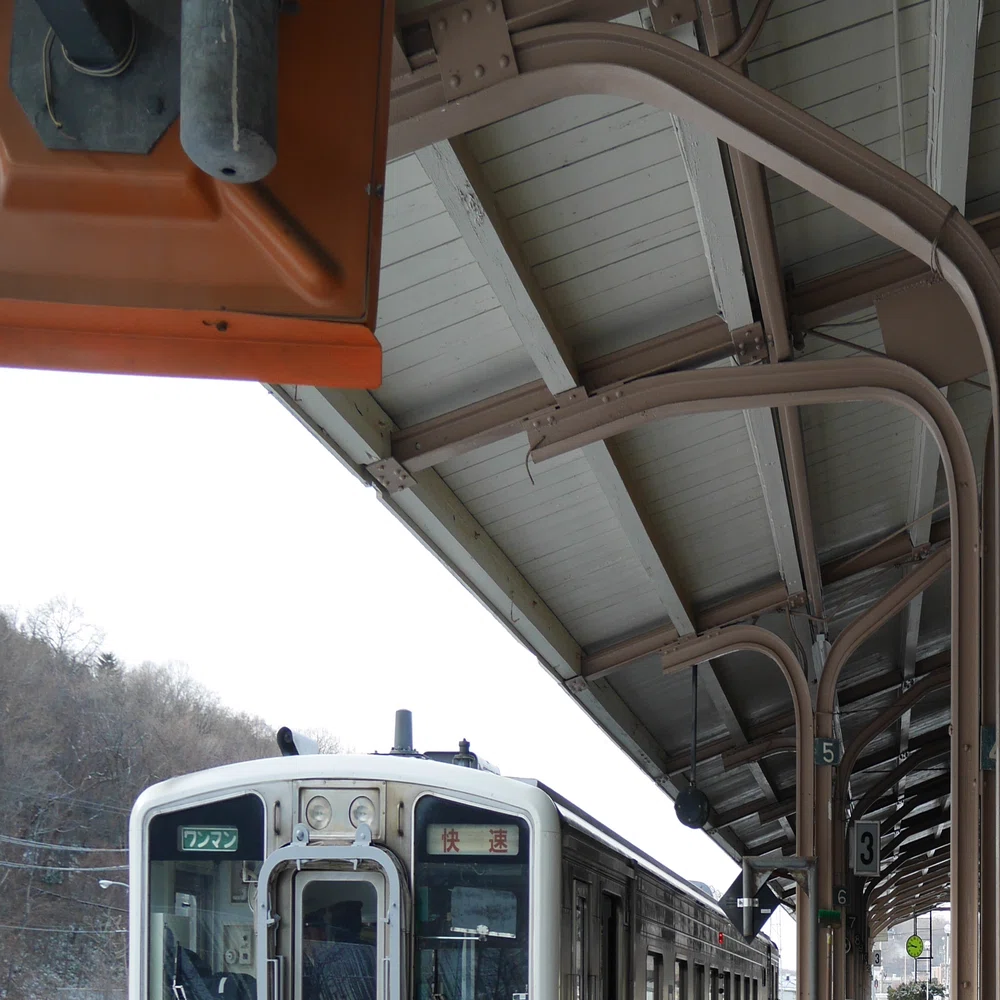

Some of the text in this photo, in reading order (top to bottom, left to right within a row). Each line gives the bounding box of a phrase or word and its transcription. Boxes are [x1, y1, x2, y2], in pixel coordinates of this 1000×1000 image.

[822, 742, 835, 763] 5
[184, 830, 237, 849] ワンマン
[441, 828, 508, 853] 快速
[860, 831, 874, 866] 3
[837, 889, 847, 905] 6
[848, 916, 856, 929] 7
[874, 953, 880, 964] 3
